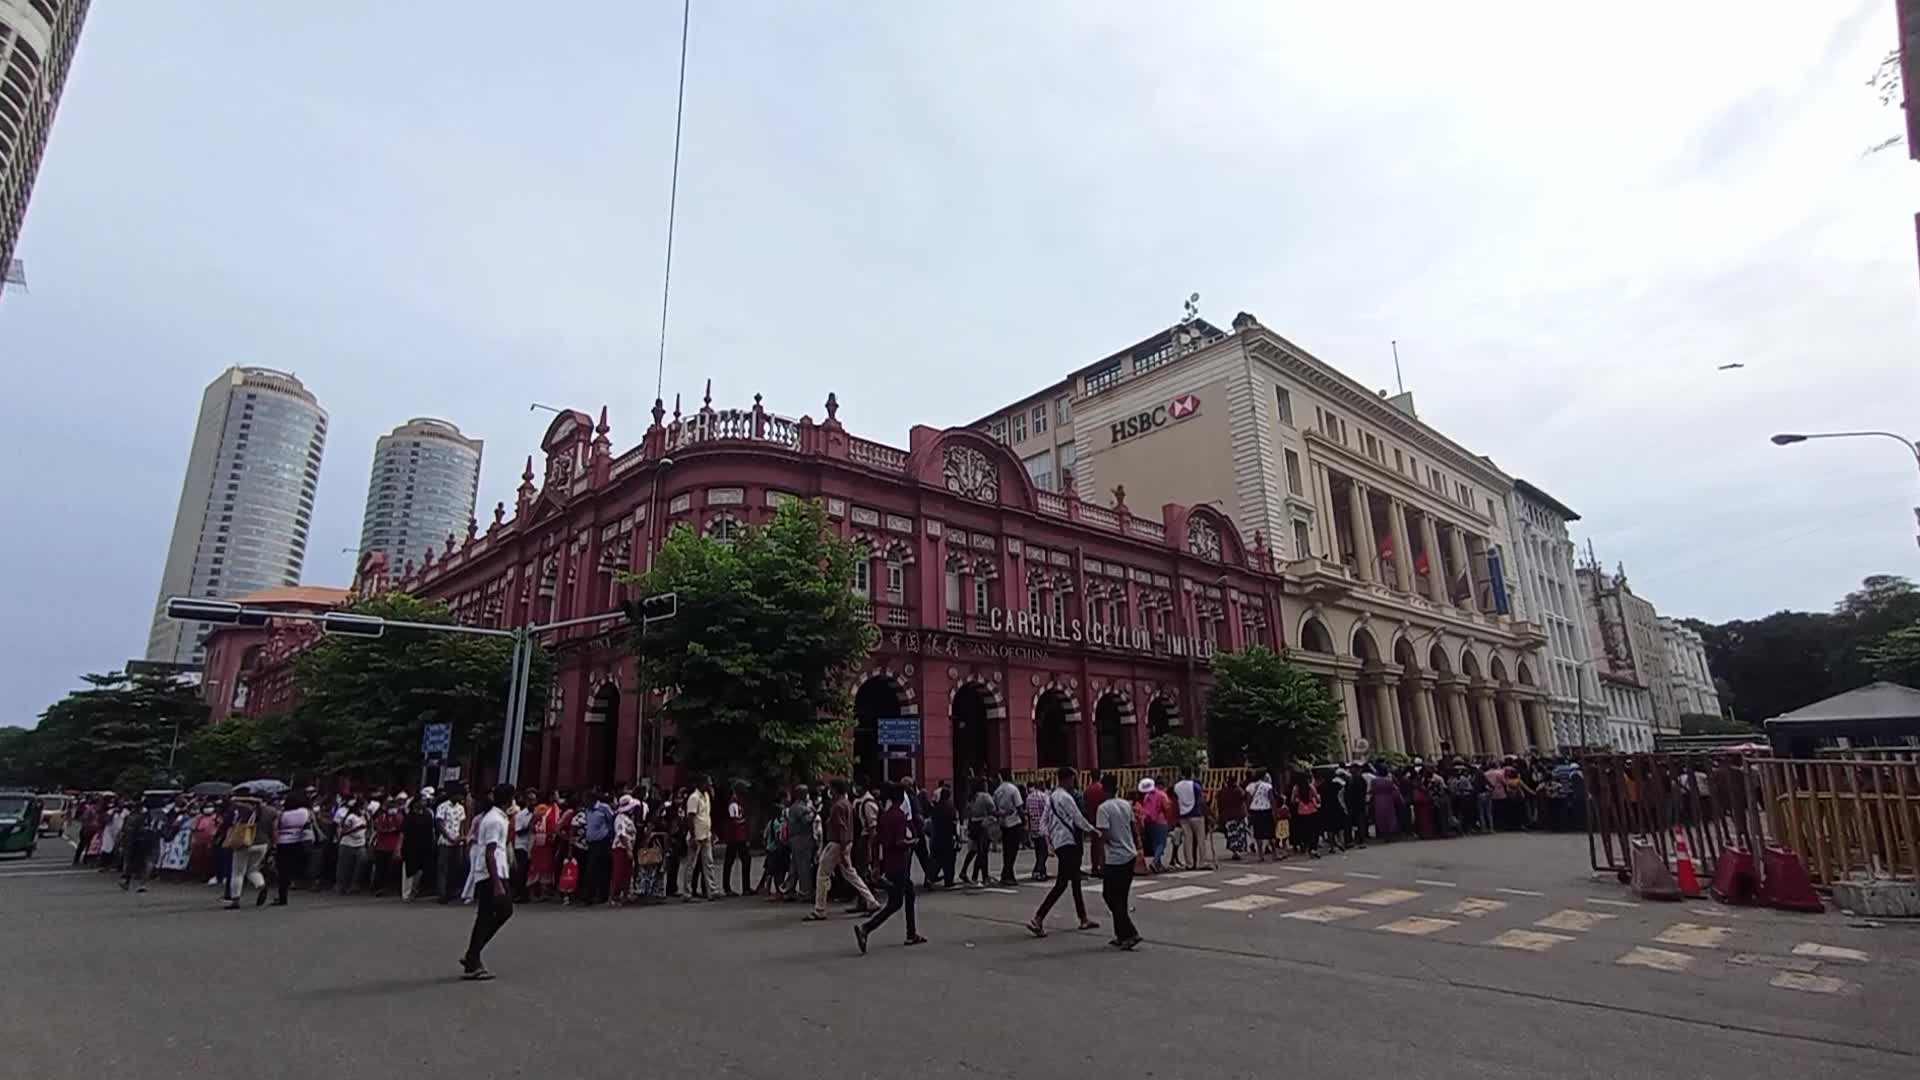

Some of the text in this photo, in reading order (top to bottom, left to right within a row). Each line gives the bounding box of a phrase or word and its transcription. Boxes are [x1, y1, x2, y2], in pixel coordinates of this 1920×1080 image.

[1111, 405, 1167, 443] HSBC
[991, 607, 1082, 642] CARGILLS
[1162, 631, 1212, 658] IMITED
